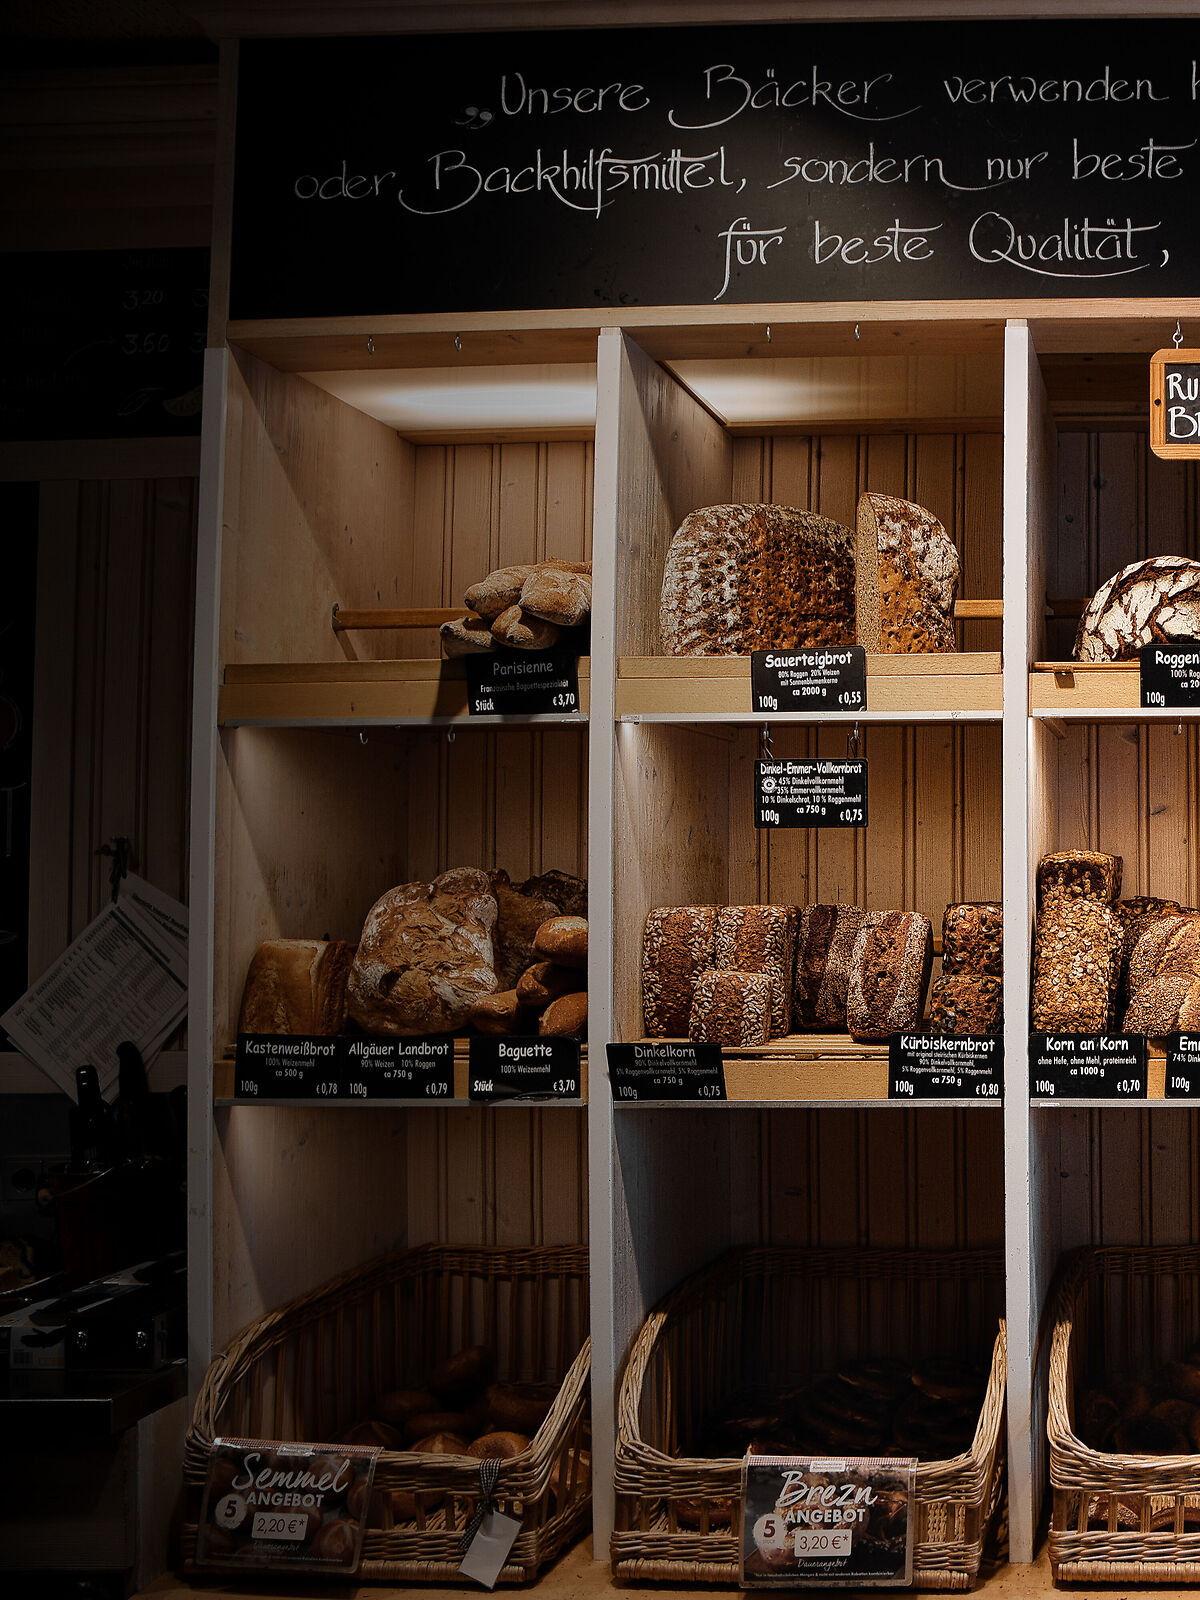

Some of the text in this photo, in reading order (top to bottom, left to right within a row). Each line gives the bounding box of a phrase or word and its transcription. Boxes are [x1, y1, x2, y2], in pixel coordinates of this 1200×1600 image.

[668, 65, 922, 129] Bäcker
[943, 66, 1170, 104] verwenden
[294, 160, 403, 200] oder
[399, 149, 747, 219] Backhilfsmittel,
[768, 143, 1015, 191] sondern
[986, 151, 1049, 180] nur
[1072, 137, 1198, 181] beste
[713, 217, 788, 300] für
[813, 218, 943, 265] beste
[765, 651, 852, 668] Sauerteigbrot
[493, 661, 553, 675] Parisienne
[1171, 670, 1187, 678] 100%
[802, 687, 820, 695] 2000
[476, 698, 494, 711] Stück
[759, 696, 777, 710] 100g
[1147, 692, 1165, 706] 100g
[806, 805, 819, 813] 750
[761, 810, 779, 824] 100g
[246, 1040, 335, 1056] Kastenweißbrot
[349, 1042, 449, 1059] Allgäuer Landbrot
[901, 1036, 995, 1051] Kürbiskernbrot
[1047, 1037, 1128, 1051] Korn an Korn
[499, 1043, 552, 1061] Baguette
[635, 1046, 695, 1058] Dinkelkorn
[1103, 1056, 1136, 1065] proteinreich
[393, 1070, 406, 1078] 750
[1080, 1067, 1098, 1075] 1000
[474, 1080, 493, 1092] Stück
[941, 1076, 955, 1084] 750
[1171, 1077, 1190, 1092] 100g
[241, 1081, 258, 1095] 100g
[350, 1083, 367, 1097] 100g
[619, 1086, 638, 1099] 100g
[896, 1081, 913, 1096] 100g
[1036, 1080, 1054, 1095] 100g
[231, 1453, 350, 1493] Semmel
[775, 1470, 878, 1508] Brezn
[245, 1492, 324, 1507] ANGEBOT
[224, 1500, 237, 1517] 5
[785, 1509, 866, 1523] ANGEBOT
[257, 1518, 285, 1534] 2,20
[763, 1520, 776, 1538] 5
[800, 1536, 828, 1550] 3,20
[798, 1559, 848, 1571] Dauerangebot
